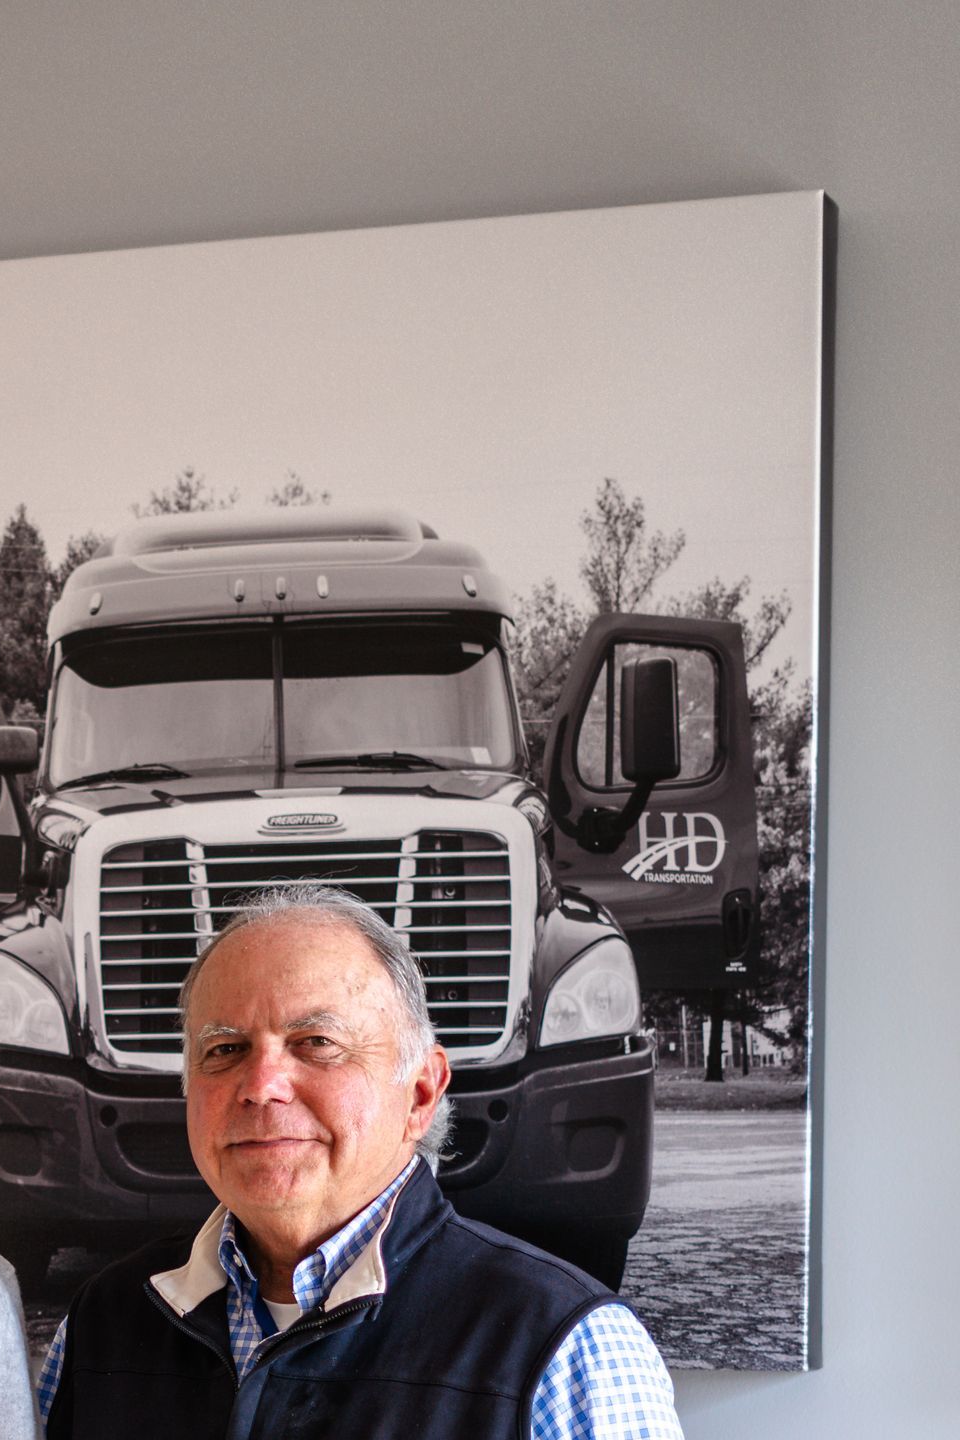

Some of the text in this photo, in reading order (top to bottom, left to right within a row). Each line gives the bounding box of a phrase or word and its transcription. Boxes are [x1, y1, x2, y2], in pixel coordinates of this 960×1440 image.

[269, 815, 335, 826] FREIGHTLINER
[638, 811, 726, 872] HD
[644, 872, 713, 884] TRANSPORTATION
